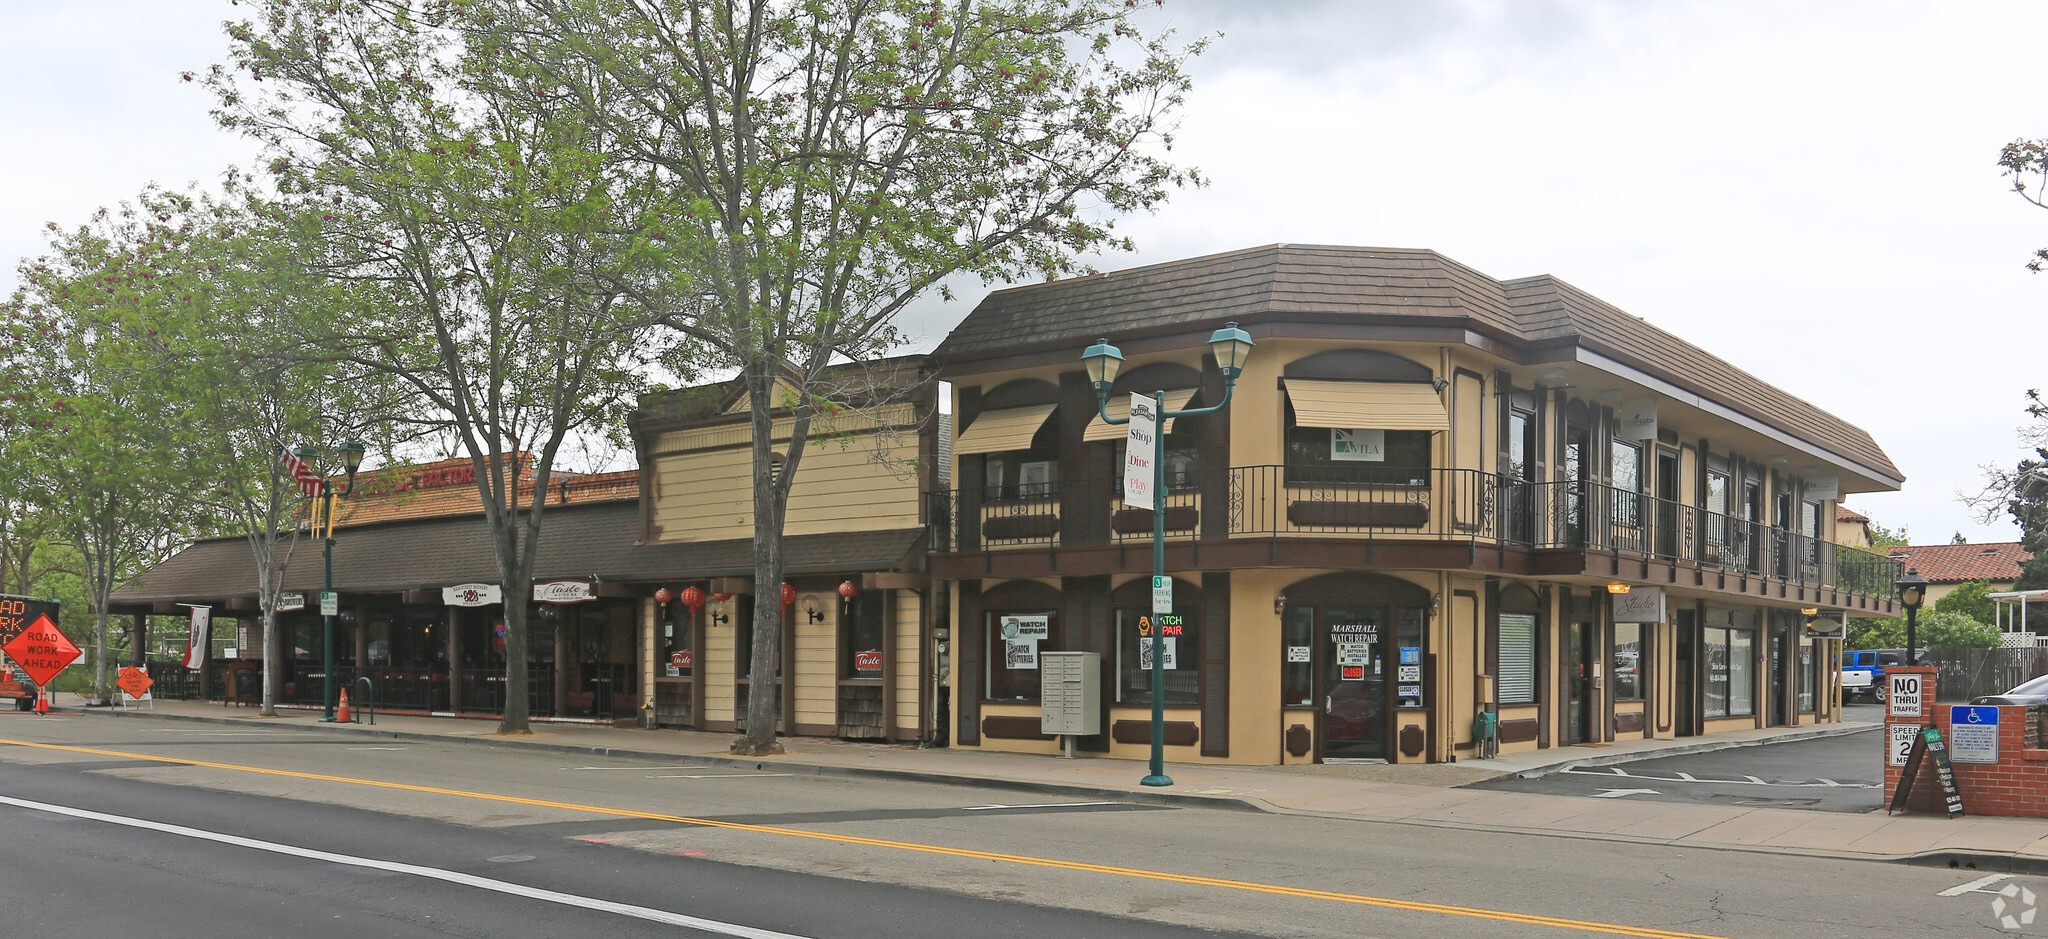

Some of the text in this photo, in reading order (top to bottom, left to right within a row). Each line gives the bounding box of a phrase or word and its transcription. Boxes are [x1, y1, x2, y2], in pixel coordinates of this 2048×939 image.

[1130, 428, 1152, 445] Shop
[1343, 441, 1379, 455] AVILA
[1130, 455, 1149, 468] Dine
[422, 465, 475, 488] FACTOR
[1130, 478, 1148, 491] Play
[548, 583, 581, 594] Taste
[1155, 579, 1160, 587] 3
[1154, 589, 1171, 597] PARKING
[1616, 594, 1654, 616] Studio
[1151, 626, 1182, 635] PAIR
[1331, 625, 1378, 633] MARSHALL
[28, 632, 58, 642] ROAD
[1331, 634, 1378, 643] WATCH REPAIR
[28, 645, 58, 656] WORK
[23, 658, 61, 669] AHEAD
[672, 653, 692, 664] Taste
[857, 653, 880, 665] Taste
[1343, 667, 1362, 677] CLOSED
[1894, 678, 1918, 694] NO
[1894, 696, 1918, 704] THRU
[1894, 705, 1918, 713] TRAFFIC
